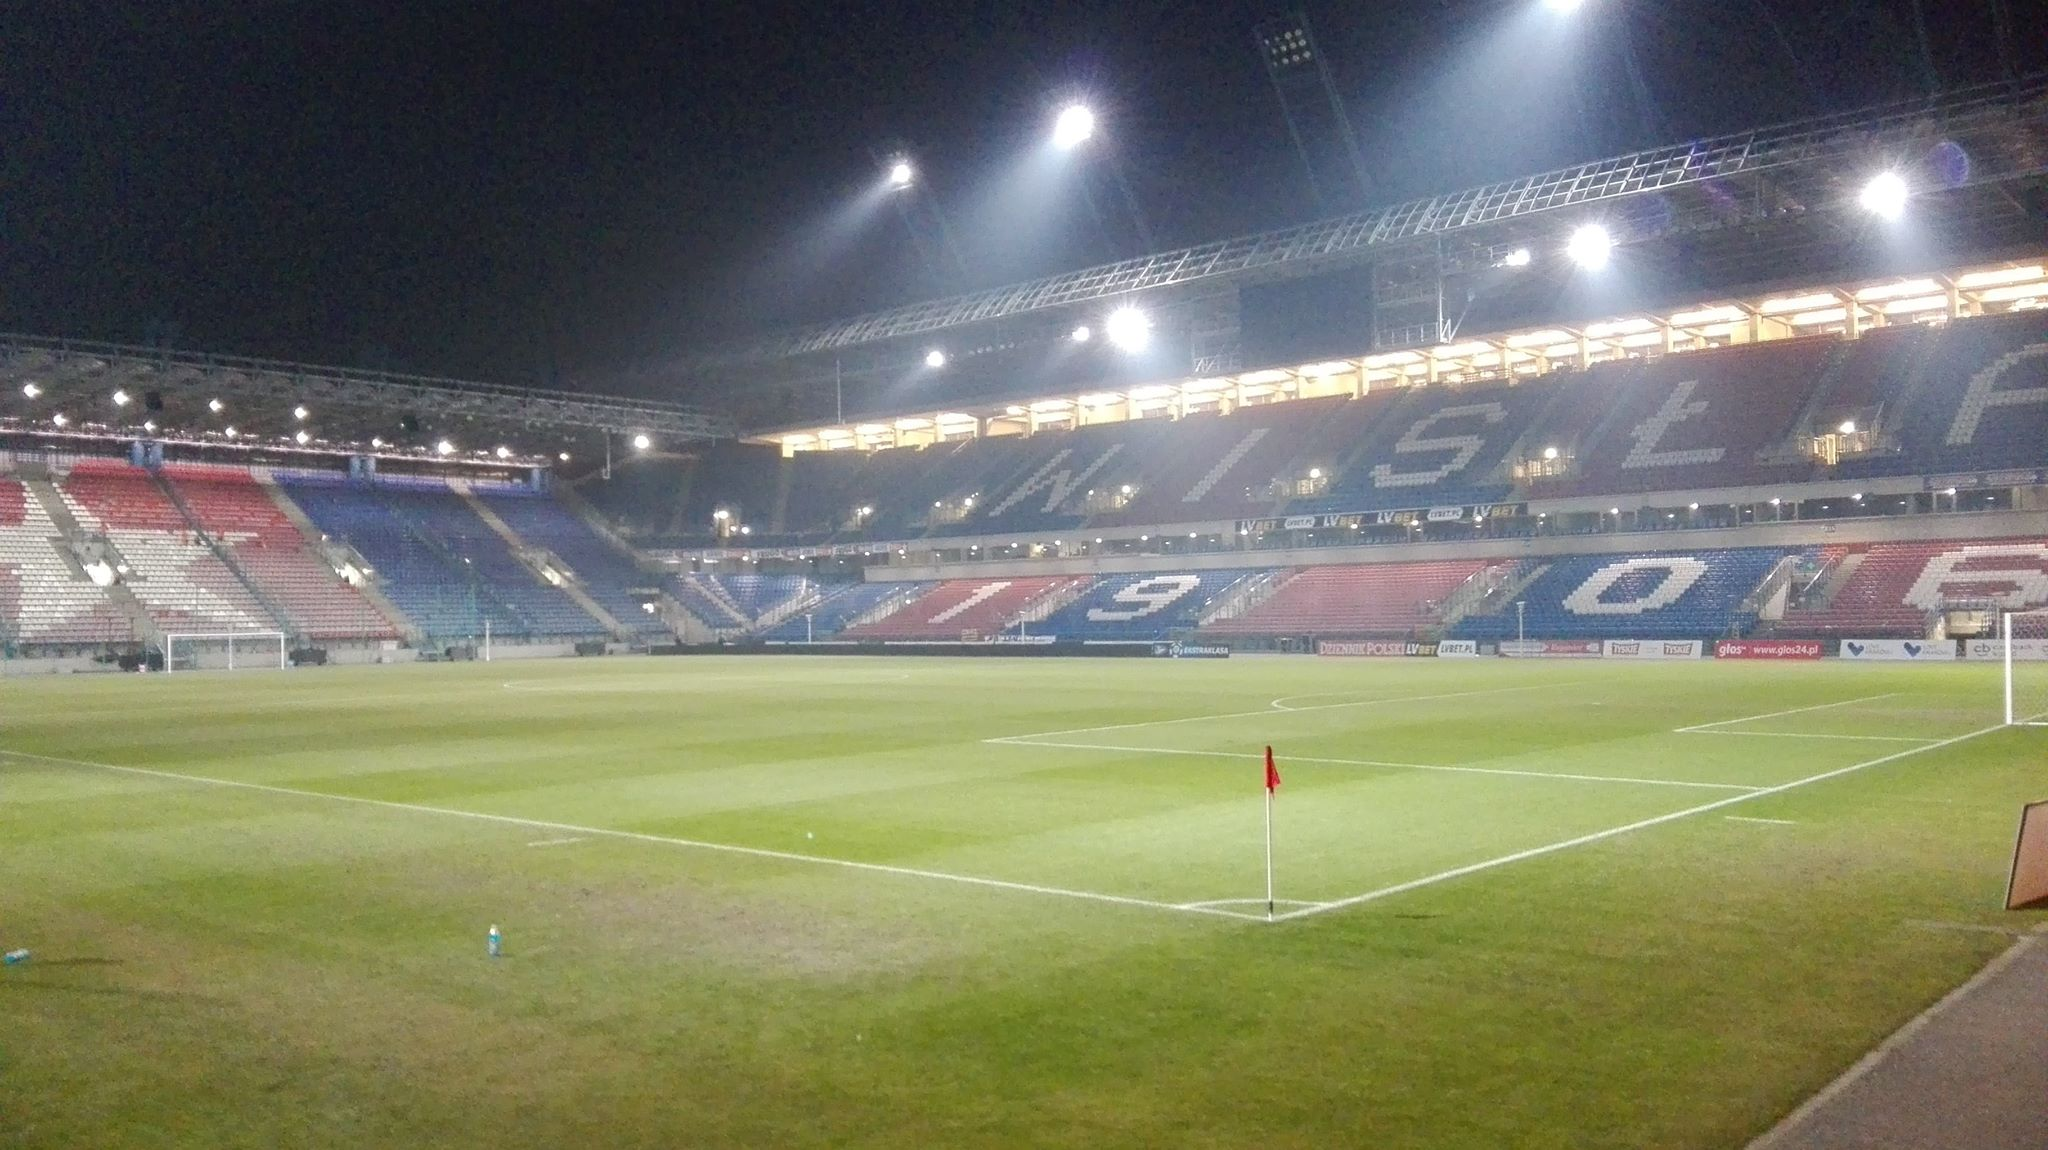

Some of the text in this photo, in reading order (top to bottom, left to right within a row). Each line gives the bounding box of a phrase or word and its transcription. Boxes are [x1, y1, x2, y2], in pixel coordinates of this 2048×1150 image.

[1184, 646, 1229, 654] EKSTRAKLASA
[1320, 640, 1405, 655] DZIENNIK POLSKI
[1613, 643, 1640, 655] TYSKIE
[1664, 643, 1692, 655] TYSKIE
